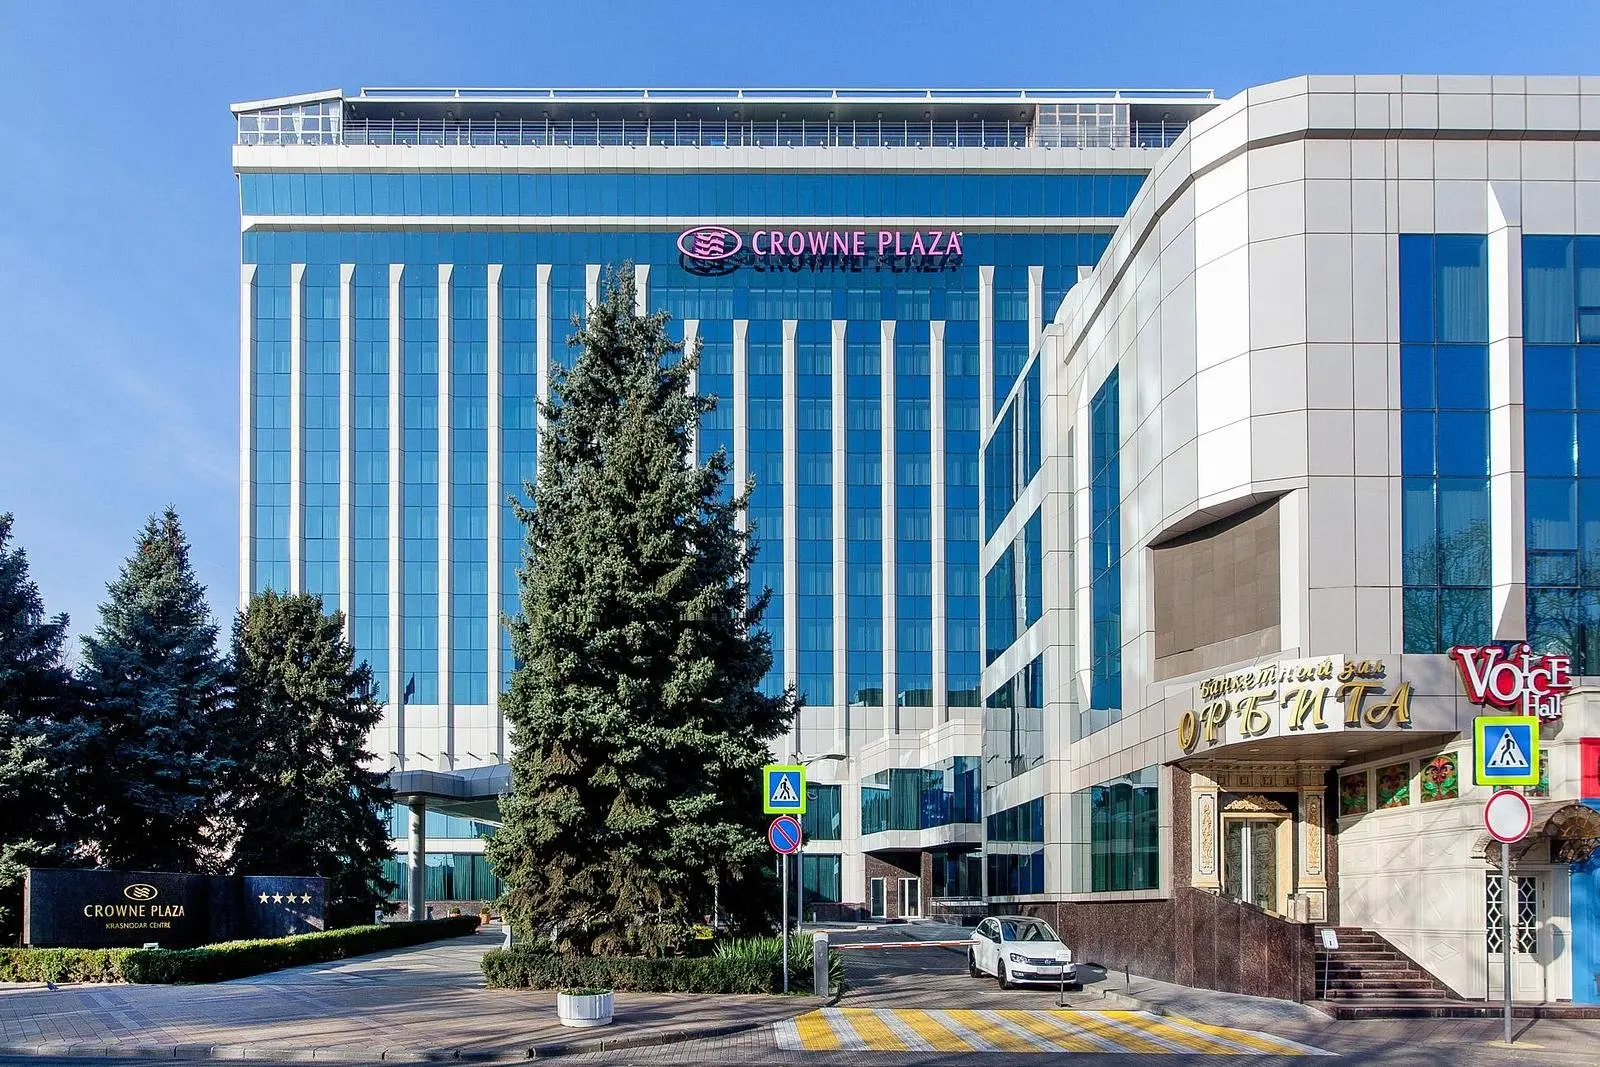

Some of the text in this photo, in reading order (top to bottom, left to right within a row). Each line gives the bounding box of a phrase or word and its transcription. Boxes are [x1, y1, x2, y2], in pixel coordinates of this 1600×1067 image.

[752, 230, 963, 256] CROWNE PLAZA
[1339, 658, 1384, 681] зал
[1178, 680, 1411, 751] ОРБИТА
[83, 904, 185, 918] CROWNE PLAZA
[105, 921, 171, 930] KRASNODAR CENTRE
